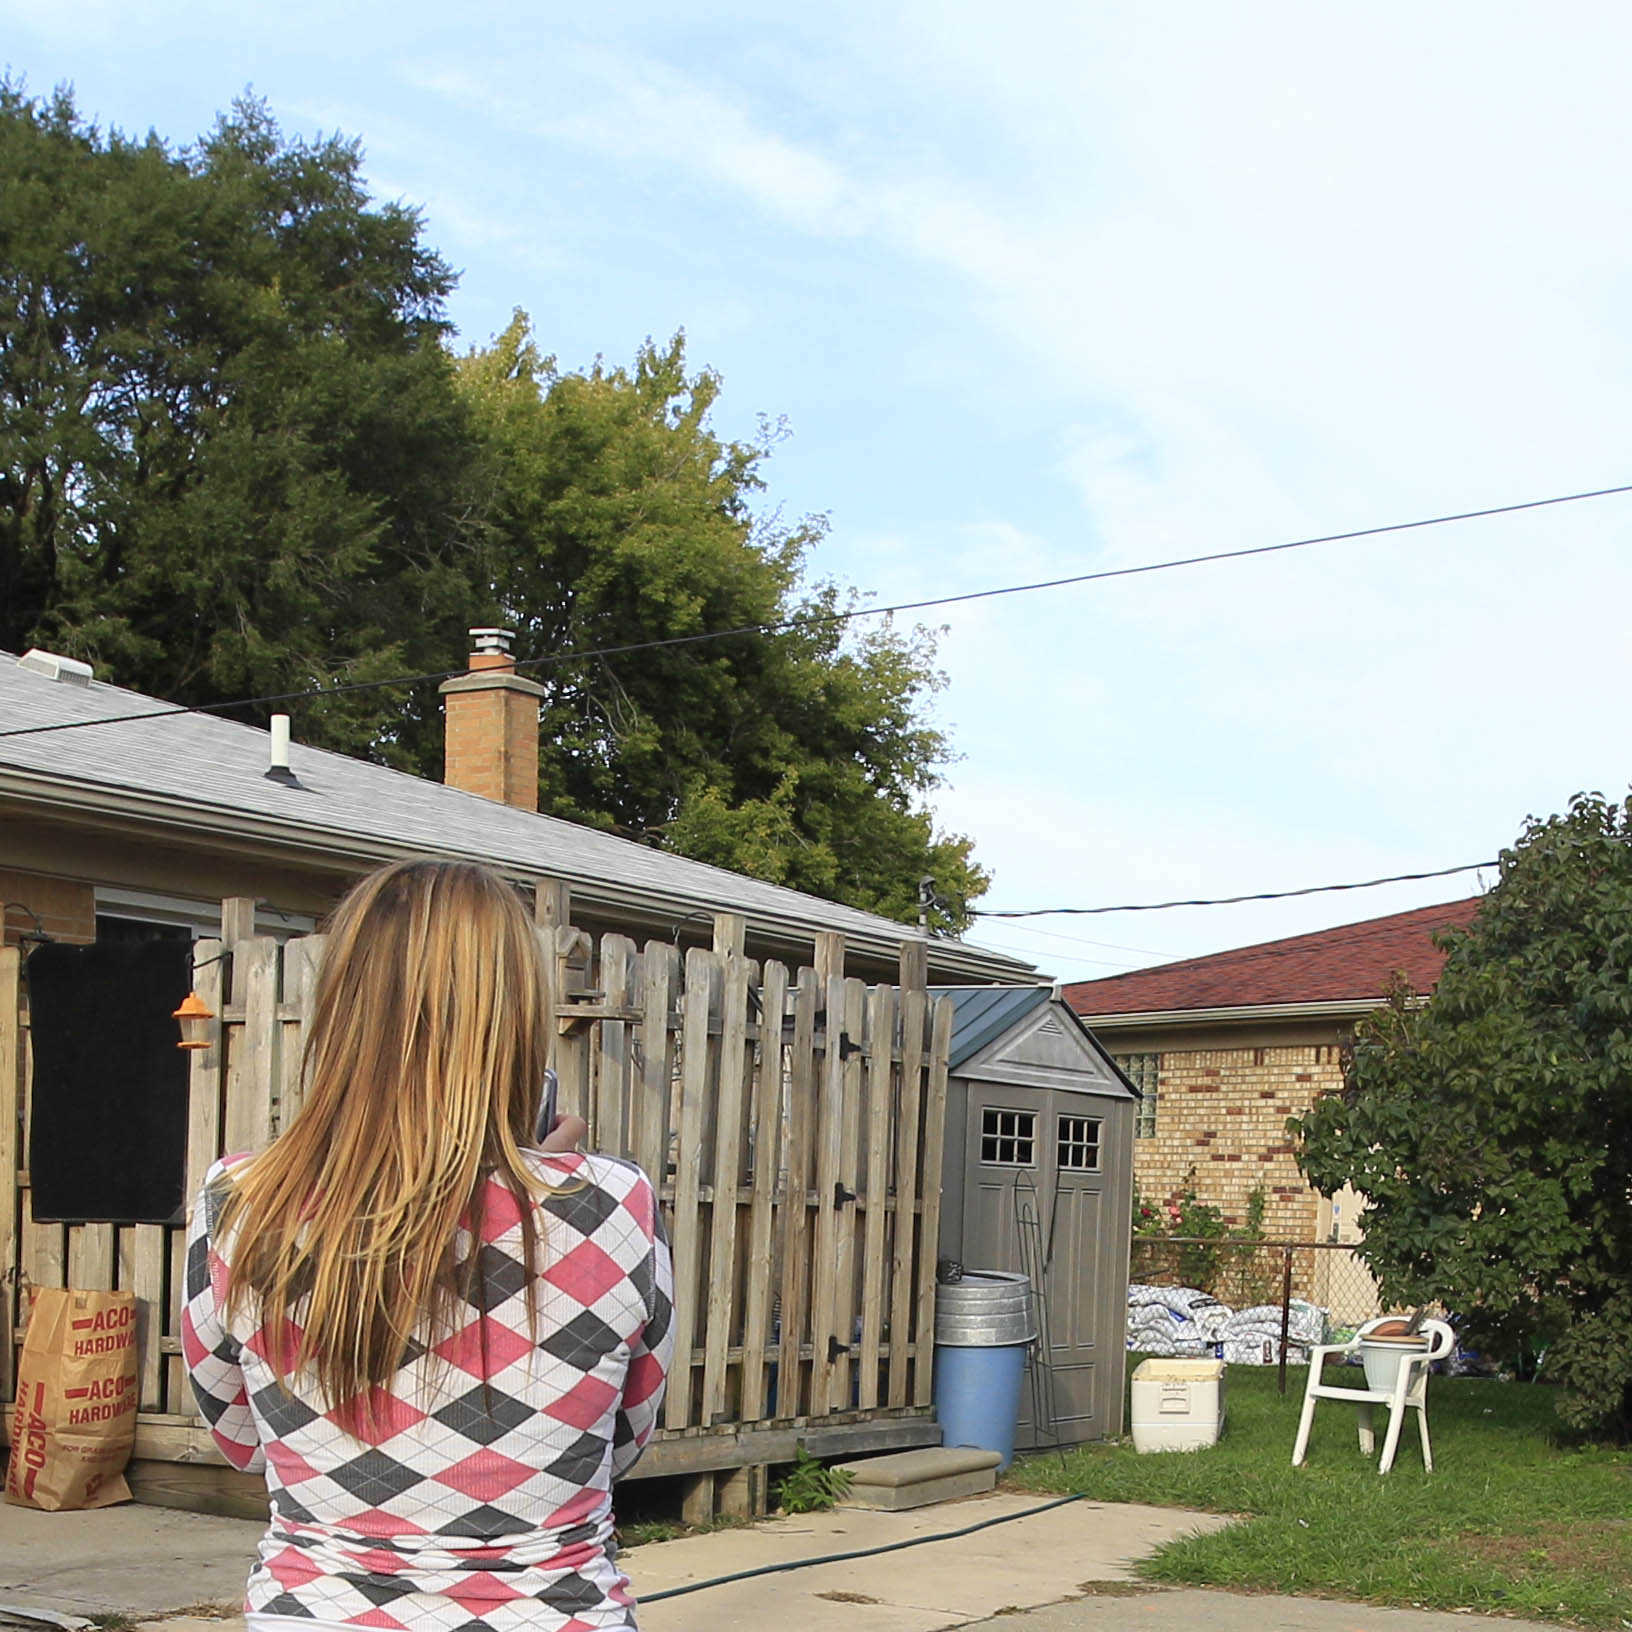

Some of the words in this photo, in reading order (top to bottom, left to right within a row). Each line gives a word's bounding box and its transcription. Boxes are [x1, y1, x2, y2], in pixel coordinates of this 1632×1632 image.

[94, 1306, 129, 1332] ACO
[89, 1375, 125, 1400] ACO
[9, 1381, 29, 1498] HARDWARE
[26, 1411, 46, 1469] ACO
